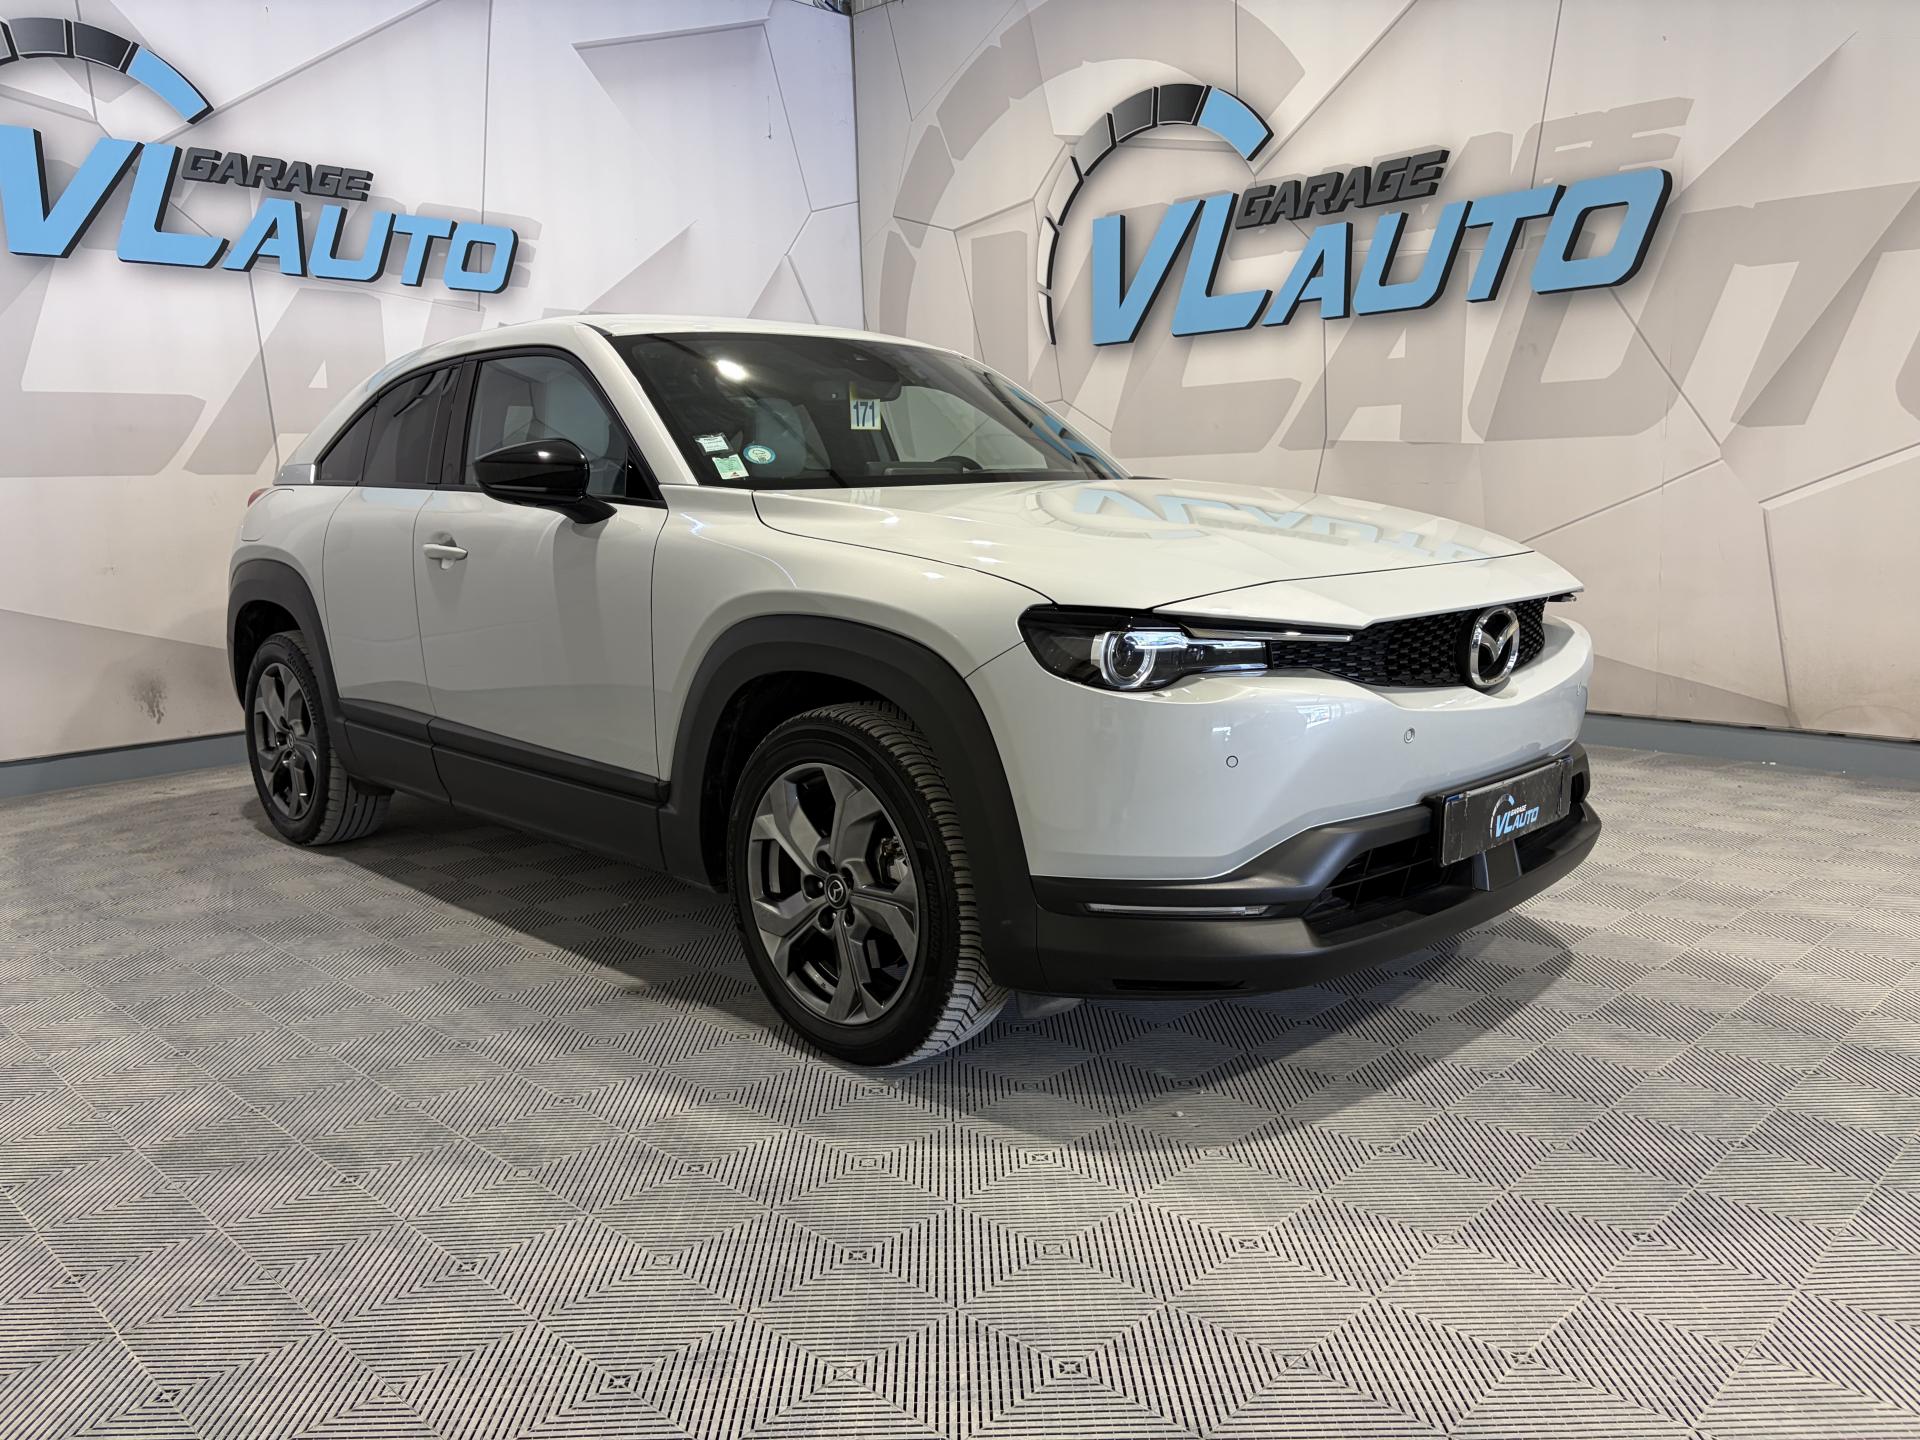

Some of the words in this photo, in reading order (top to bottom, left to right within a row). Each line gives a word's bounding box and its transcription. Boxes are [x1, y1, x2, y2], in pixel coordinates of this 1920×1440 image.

[181, 146, 373, 202] GARAGE
[1235, 149, 1450, 230] GARAGE
[853, 400, 875, 427] 171
